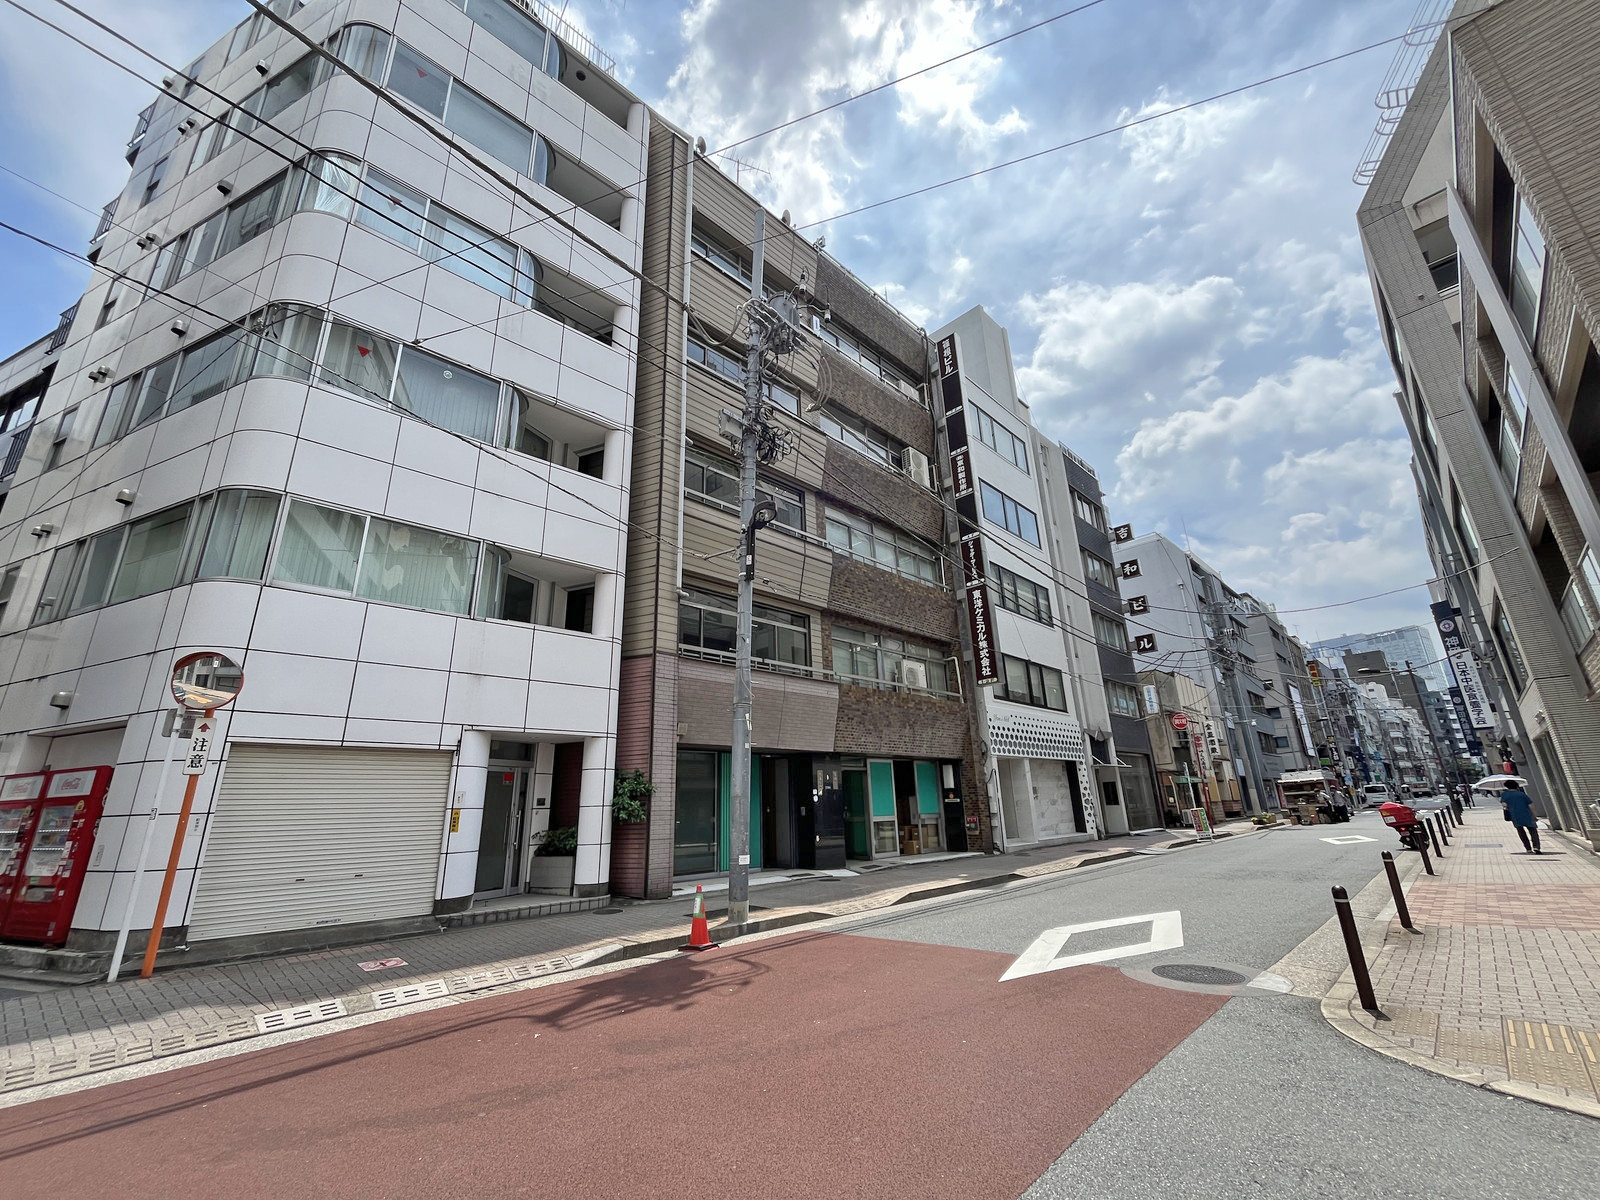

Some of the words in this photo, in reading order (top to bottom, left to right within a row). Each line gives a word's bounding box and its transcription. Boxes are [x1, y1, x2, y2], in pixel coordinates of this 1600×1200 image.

[1117, 527, 1153, 650] 吉和ビル
[972, 589, 992, 676] 東洋ケミカル株式会社
[187, 737, 209, 769] 注意
